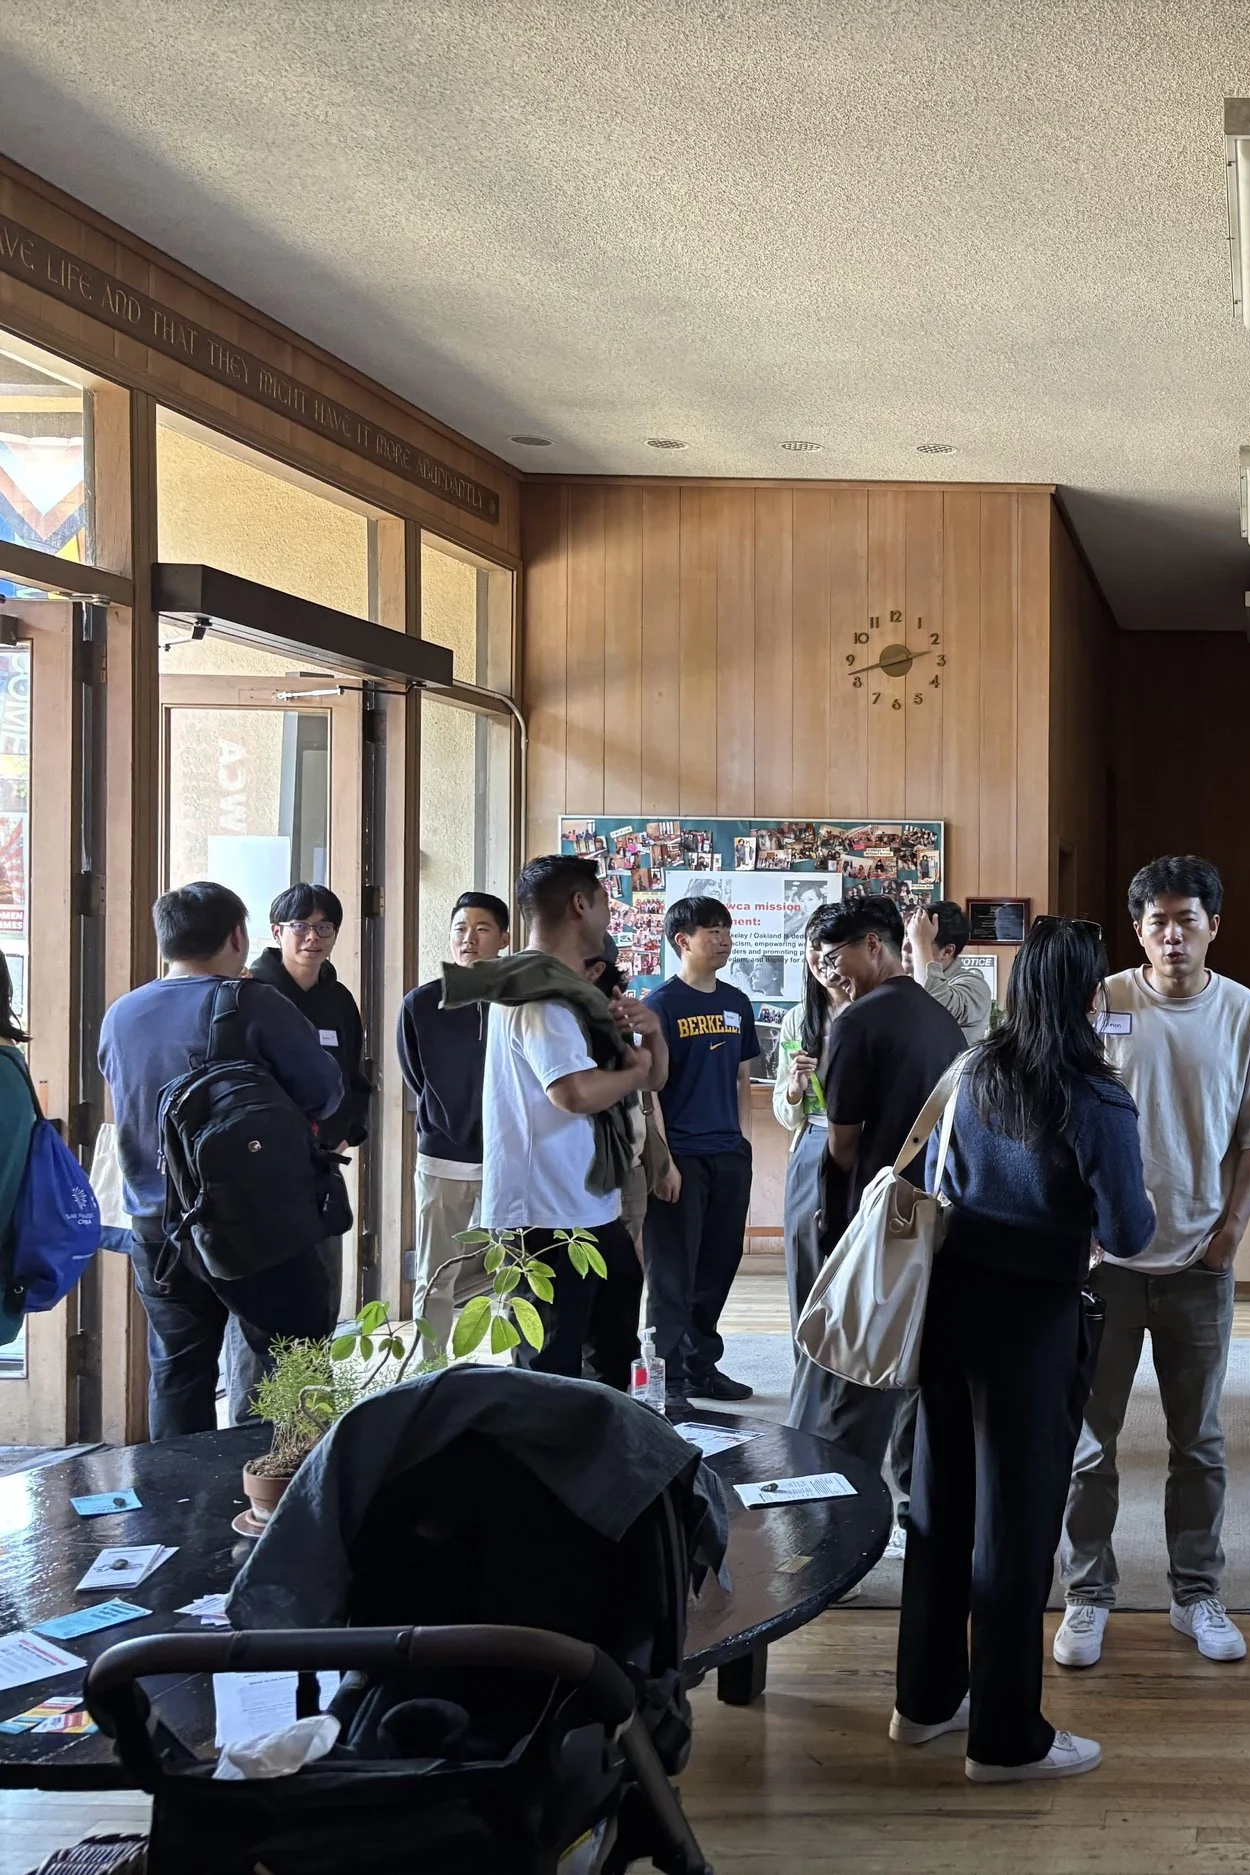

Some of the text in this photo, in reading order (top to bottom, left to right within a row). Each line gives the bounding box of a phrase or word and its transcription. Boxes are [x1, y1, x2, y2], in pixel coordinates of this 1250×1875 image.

[101, 283, 141, 324] AND
[152, 309, 198, 355] THAT
[207, 340, 249, 385] THEY
[259, 370, 306, 414] MIGHT
[315, 400, 351, 437] HAVE
[357, 423, 372, 448] IT
[376, 433, 411, 468] MORE
[415, 459, 484, 510] ABUNDANTLY
[890, 610, 902, 622] 12
[870, 616, 880, 629] 11
[854, 632, 869, 644] 10
[930, 633, 940, 645] 2
[846, 654, 855, 666] 9
[937, 654, 946, 667] 3
[853, 677, 862, 688] 8
[929, 674, 940, 688] 4
[872, 692, 881, 704] 7
[914, 693, 923, 705] 5
[892, 699, 901, 710] 6
[755, 902, 801, 911] mission
[962, 958, 992, 966] OTICE
